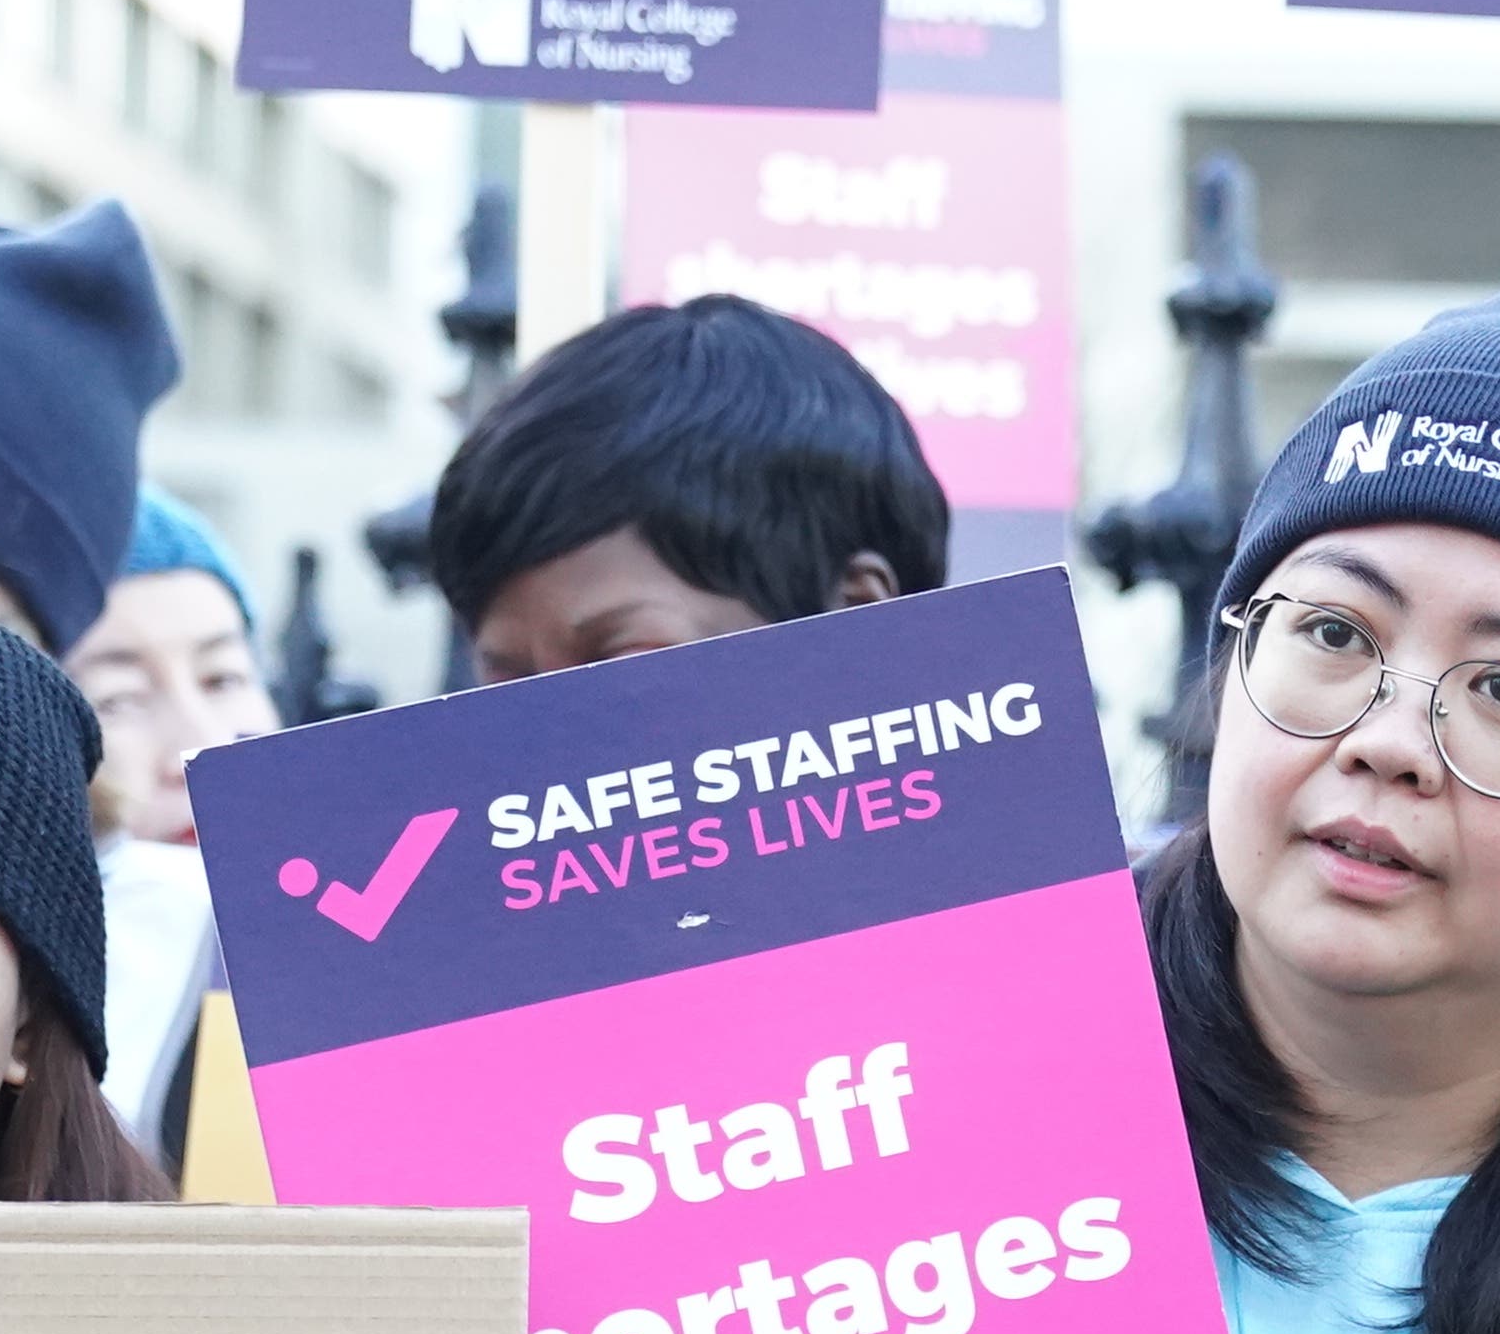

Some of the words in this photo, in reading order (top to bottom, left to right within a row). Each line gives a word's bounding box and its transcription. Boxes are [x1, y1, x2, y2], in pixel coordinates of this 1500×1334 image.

[576, 33, 693, 85] Nursing
[1401, 442, 1433, 469] of
[1411, 414, 1487, 446] Royal
[488, 761, 681, 849] SAFE
[695, 683, 1041, 803] STAFFING
[500, 819, 730, 911] SAVES
[748, 771, 942, 856] LIVES
[562, 1041, 914, 1224] Staff
